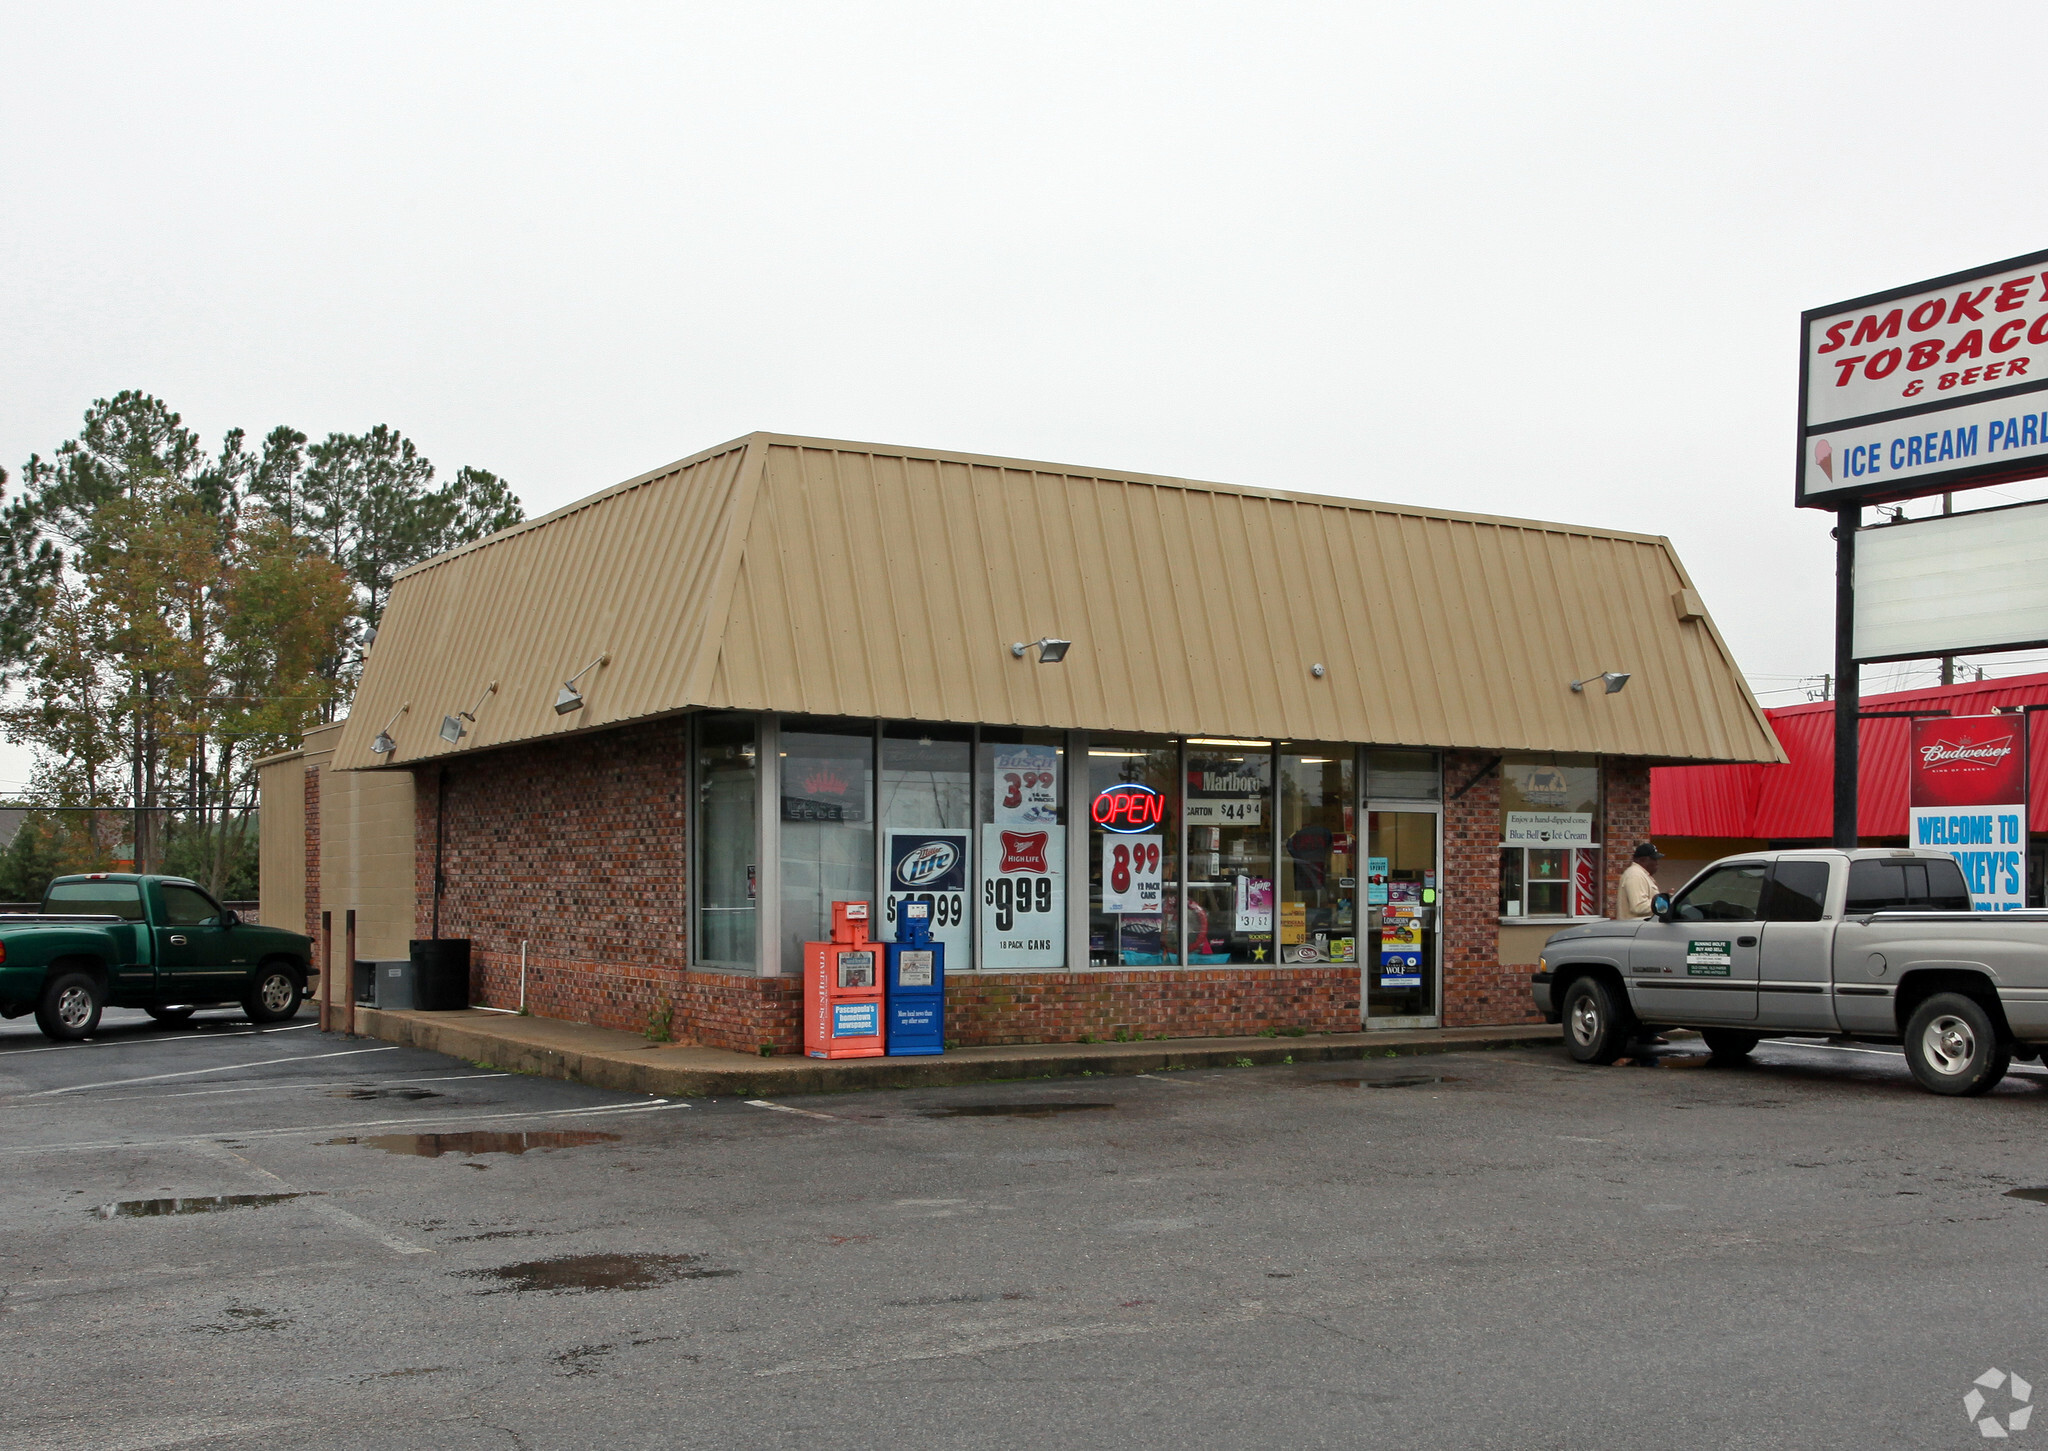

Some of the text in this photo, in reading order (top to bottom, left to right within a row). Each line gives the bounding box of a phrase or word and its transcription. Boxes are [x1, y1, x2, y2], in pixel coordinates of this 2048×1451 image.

[1817, 271, 2048, 354] SMOKE
[1902, 356, 2030, 397] & BEER
[1843, 442, 1881, 478] ICE
[1889, 424, 1978, 470] CREAM
[1920, 744, 2011, 762] Budweiser
[998, 757, 1054, 767] BUSCH
[1203, 771, 1260, 791] Marlboro
[1092, 793, 1165, 823] OPEN
[790, 809, 861, 819] SELECT
[1511, 815, 1528, 825] Enjoy
[1535, 816, 1572, 825] hand-dipped
[1509, 830, 1587, 839] Blue Bell Ice Cream
[1917, 814, 2018, 844] WELCOME TO
[1950, 851, 2019, 895] KEY'S
[1137, 882, 1160, 890] 12 PACK
[1000, 939, 1051, 950] 18 PACK CANS
[1386, 967, 1406, 975] WOLF
[835, 1005, 874, 1013] Pascagoula's
[839, 1013, 871, 1021] hometown
